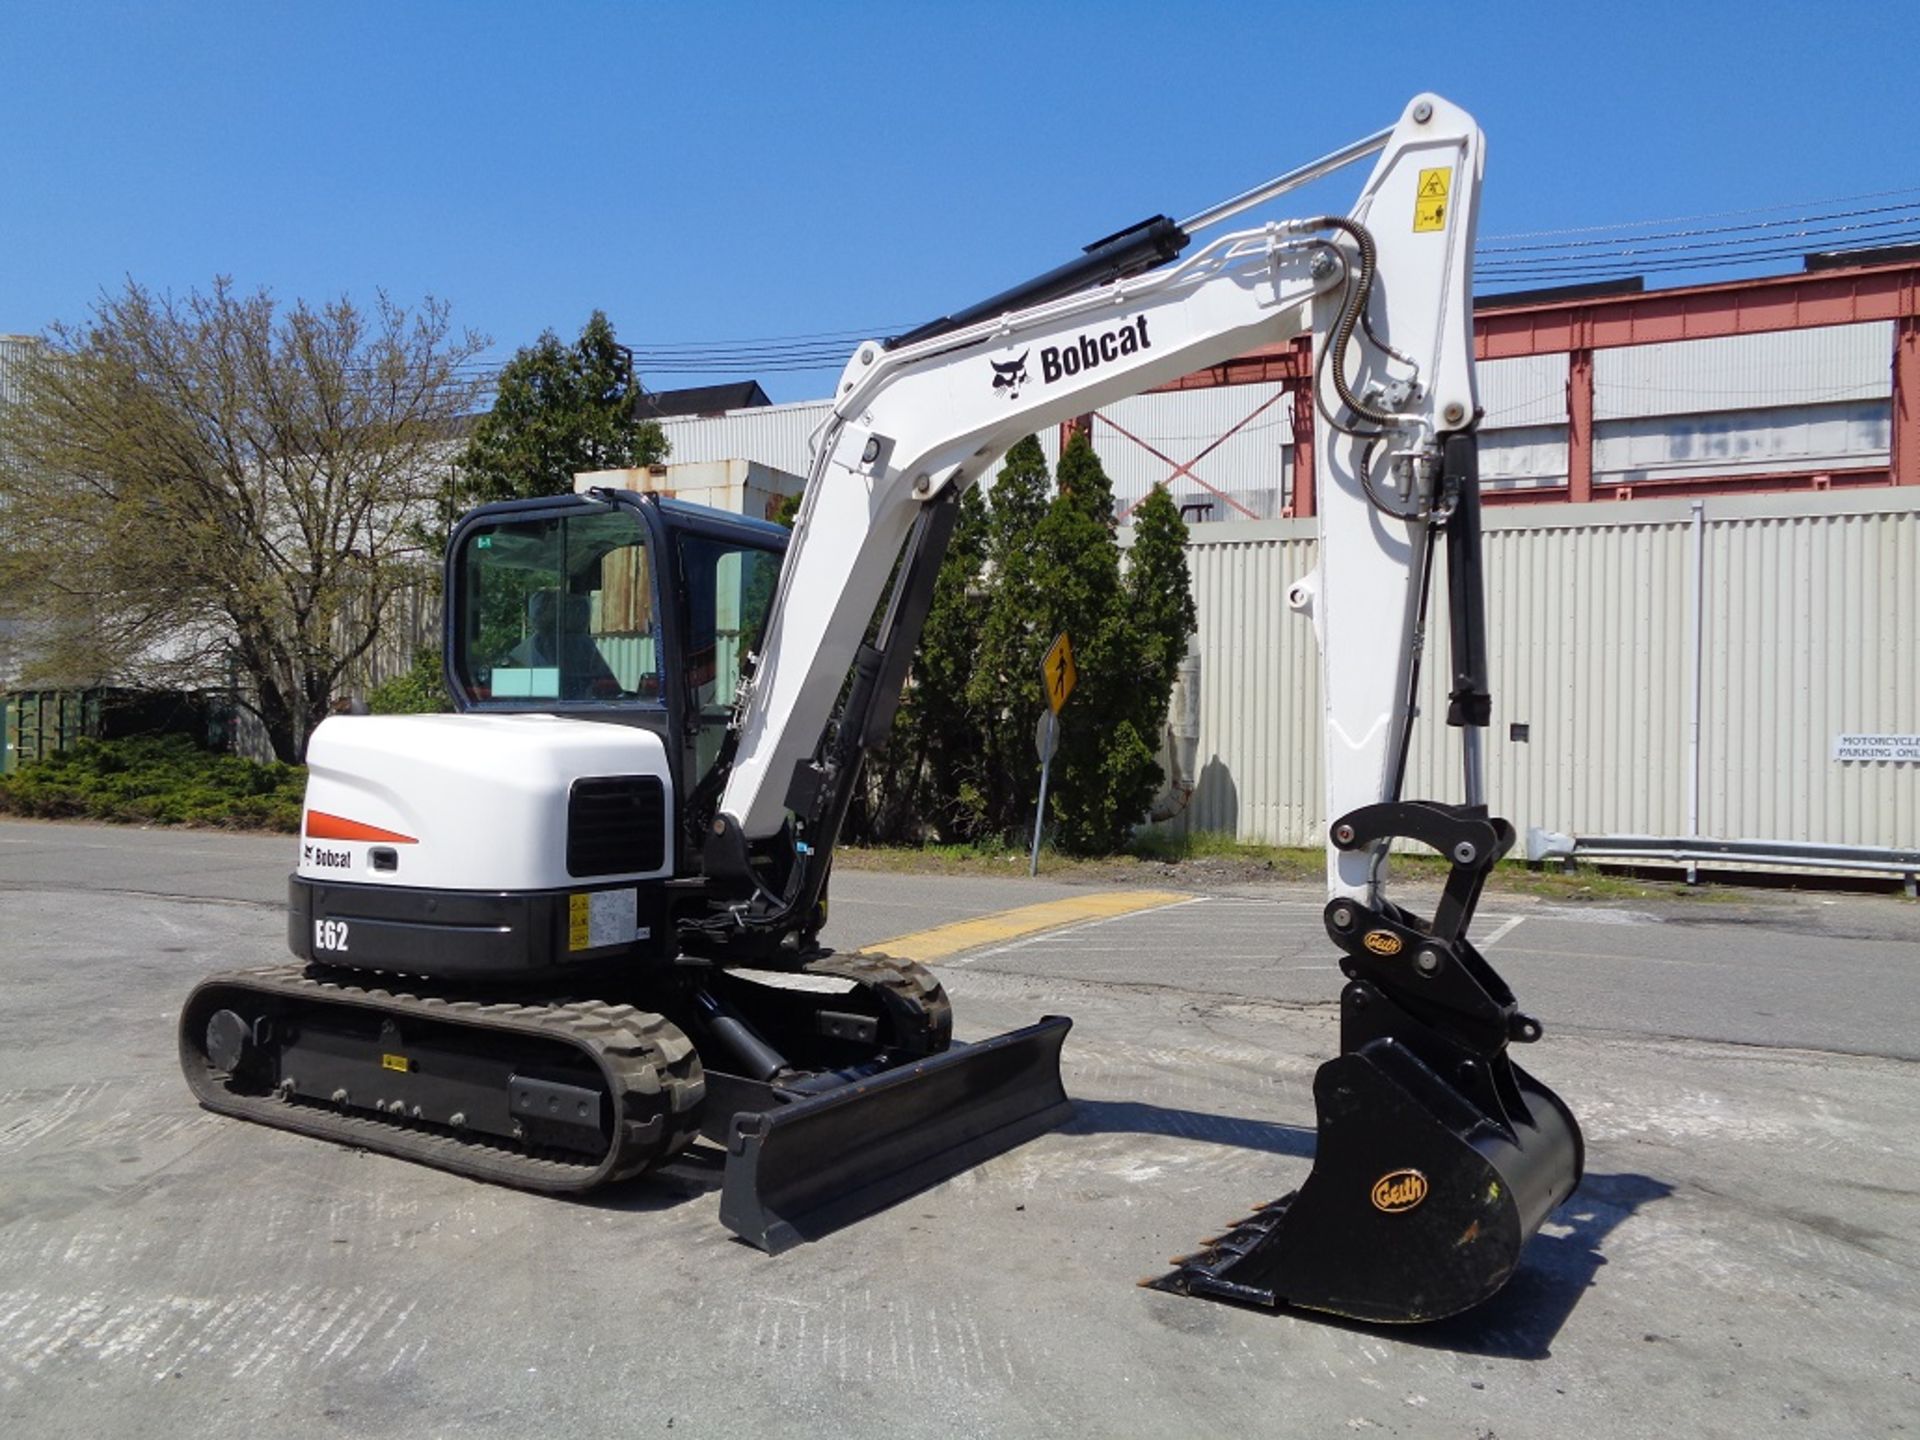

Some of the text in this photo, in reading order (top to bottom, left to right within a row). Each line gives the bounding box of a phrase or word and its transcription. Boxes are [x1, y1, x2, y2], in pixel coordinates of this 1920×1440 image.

[1041, 315, 1151, 384] Bobcat
[1839, 748, 1892, 757] PARKING
[315, 848, 351, 868] Bobcat
[315, 919, 349, 951] E62
